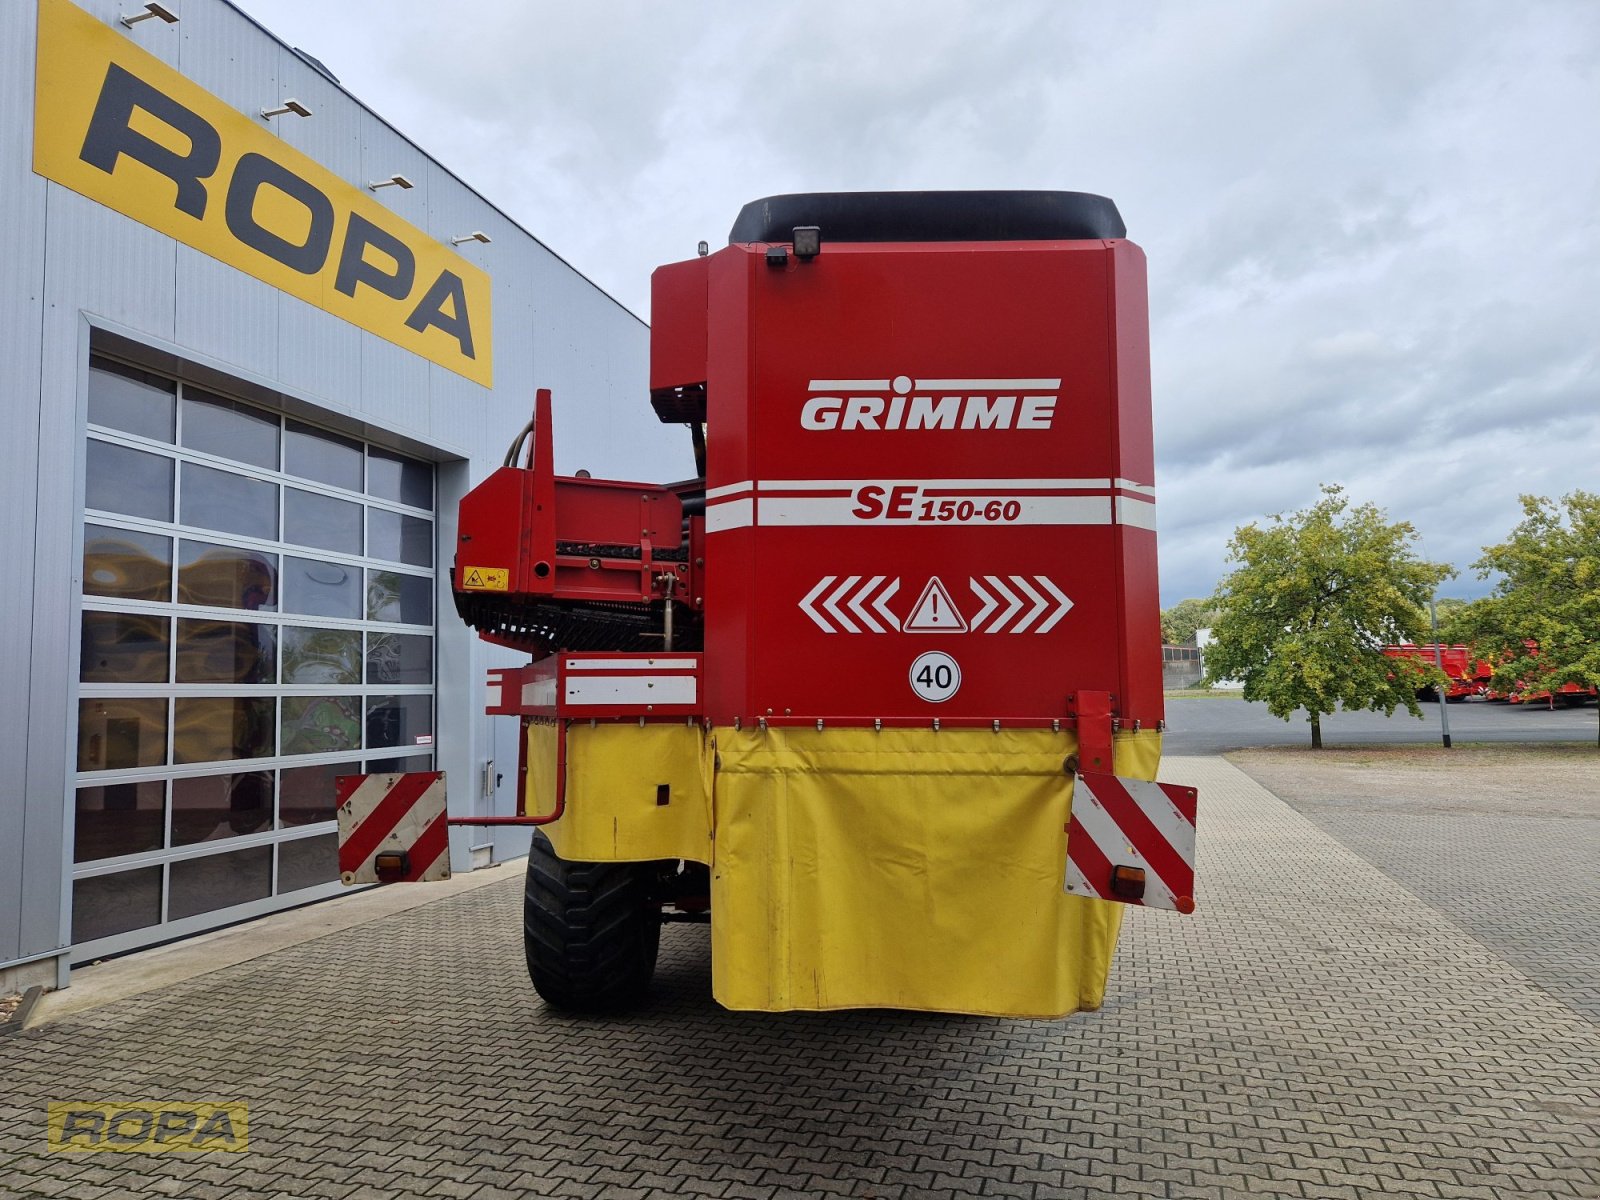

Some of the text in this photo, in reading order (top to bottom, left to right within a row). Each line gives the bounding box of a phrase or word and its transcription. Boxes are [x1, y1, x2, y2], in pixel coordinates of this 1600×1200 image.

[79, 62, 476, 361] ROPA
[800, 376, 1058, 430] GRIMME
[852, 486, 1021, 521] SE 150-60
[916, 664, 952, 689] 40
